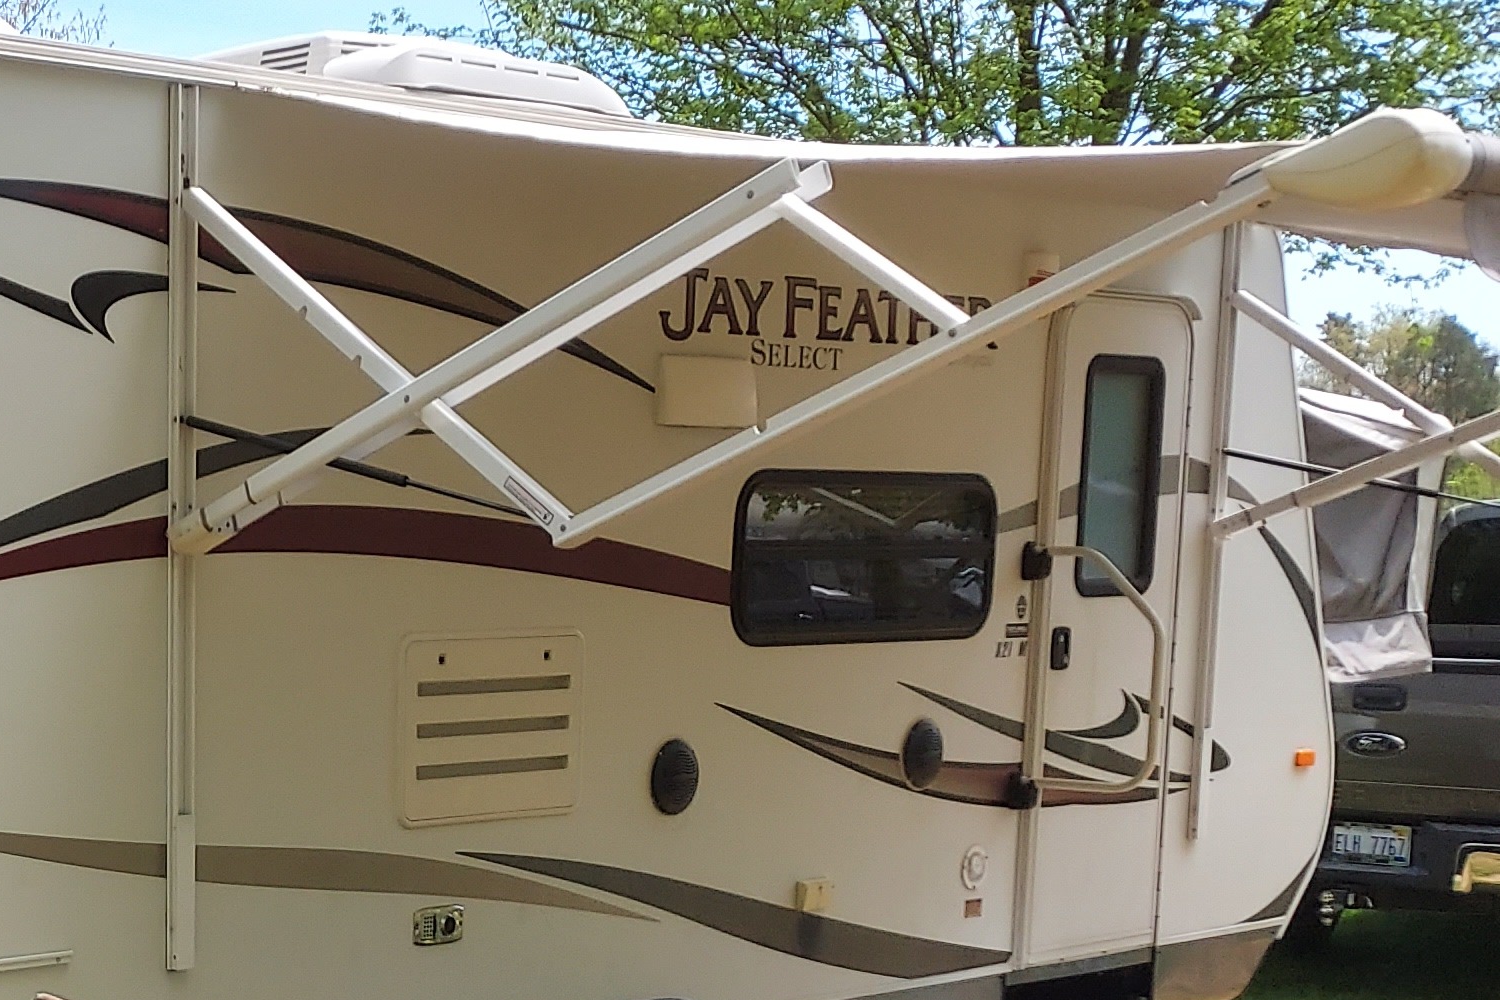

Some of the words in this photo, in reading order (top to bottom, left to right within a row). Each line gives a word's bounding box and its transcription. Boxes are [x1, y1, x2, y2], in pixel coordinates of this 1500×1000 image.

[659, 267, 773, 342] JAY
[783, 275, 998, 350] FEATH
[750, 339, 843, 371] SELECT
